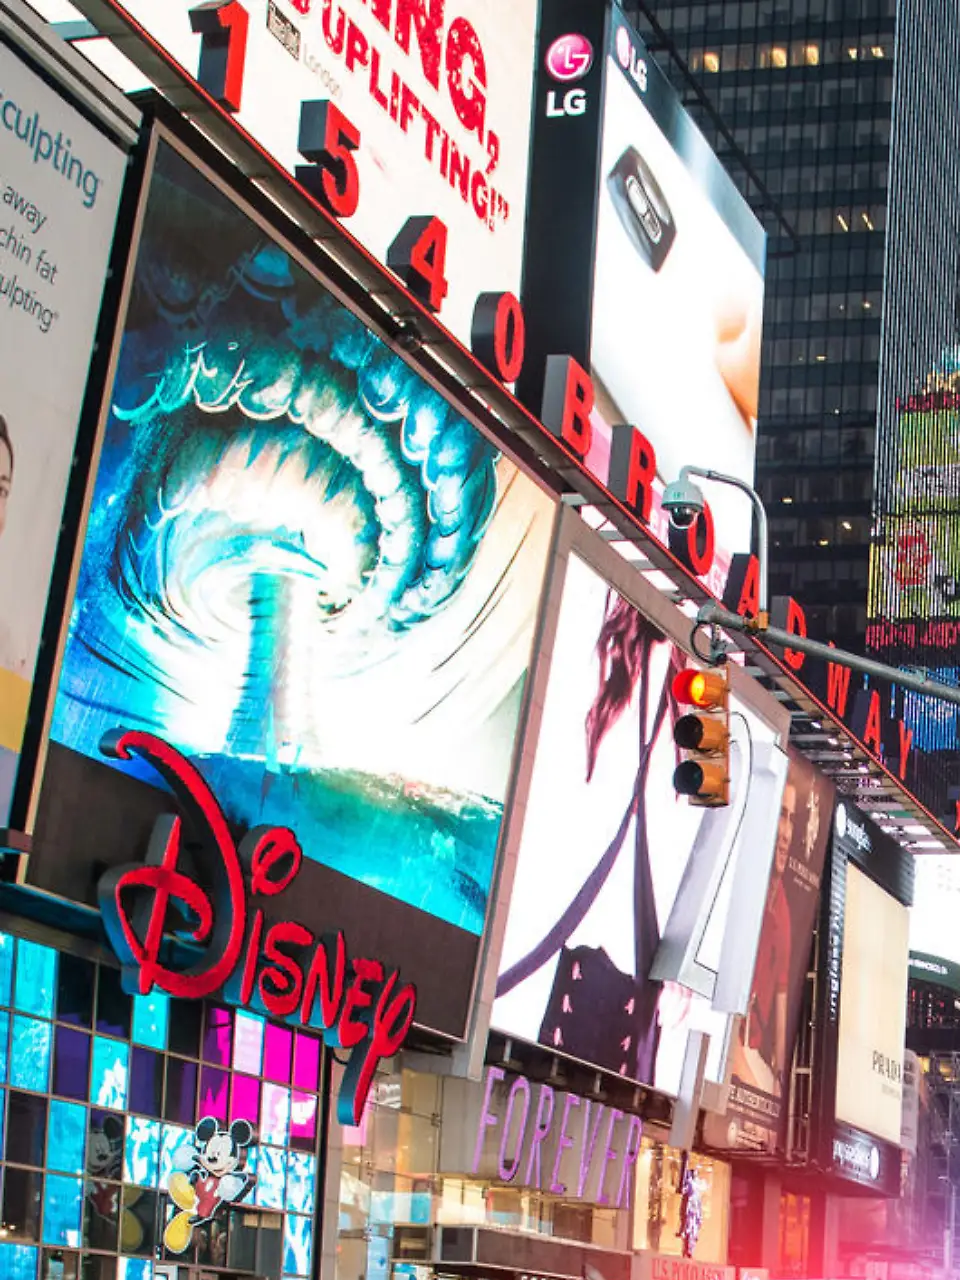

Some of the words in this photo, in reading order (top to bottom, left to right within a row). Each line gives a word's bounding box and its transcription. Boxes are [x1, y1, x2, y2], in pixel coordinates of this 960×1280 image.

[546, 88, 587, 118] LG
[0, 92, 99, 209] culpting
[3, 184, 48, 235] away
[36, 249, 58, 287] fat
[541, 354, 913, 782] BROADWAY
[471, 1066, 643, 1209] FOREVER
